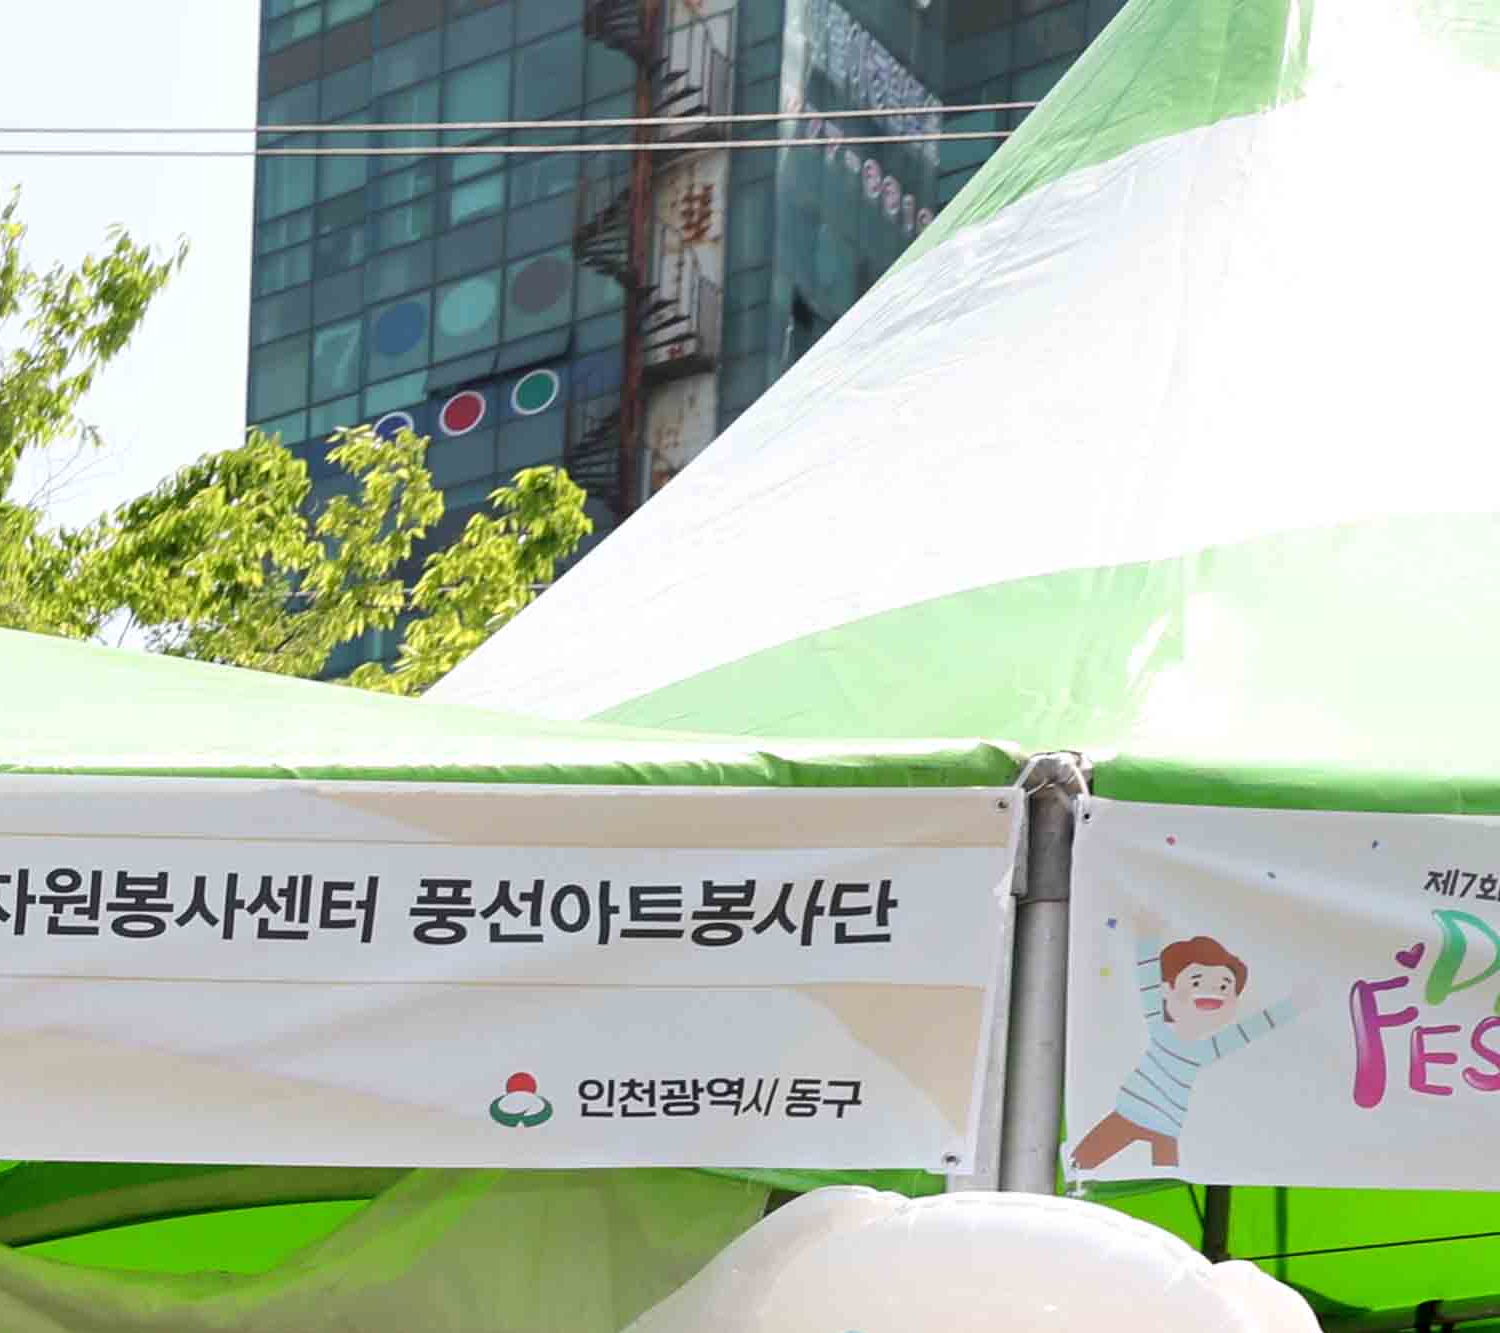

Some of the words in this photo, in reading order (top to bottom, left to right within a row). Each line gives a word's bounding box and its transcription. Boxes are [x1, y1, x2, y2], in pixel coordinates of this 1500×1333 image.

[407, 876, 899, 949] 풍선아트봉사단
[576, 1074, 780, 1119] 인천광역시
[783, 1076, 864, 1121] 동구
